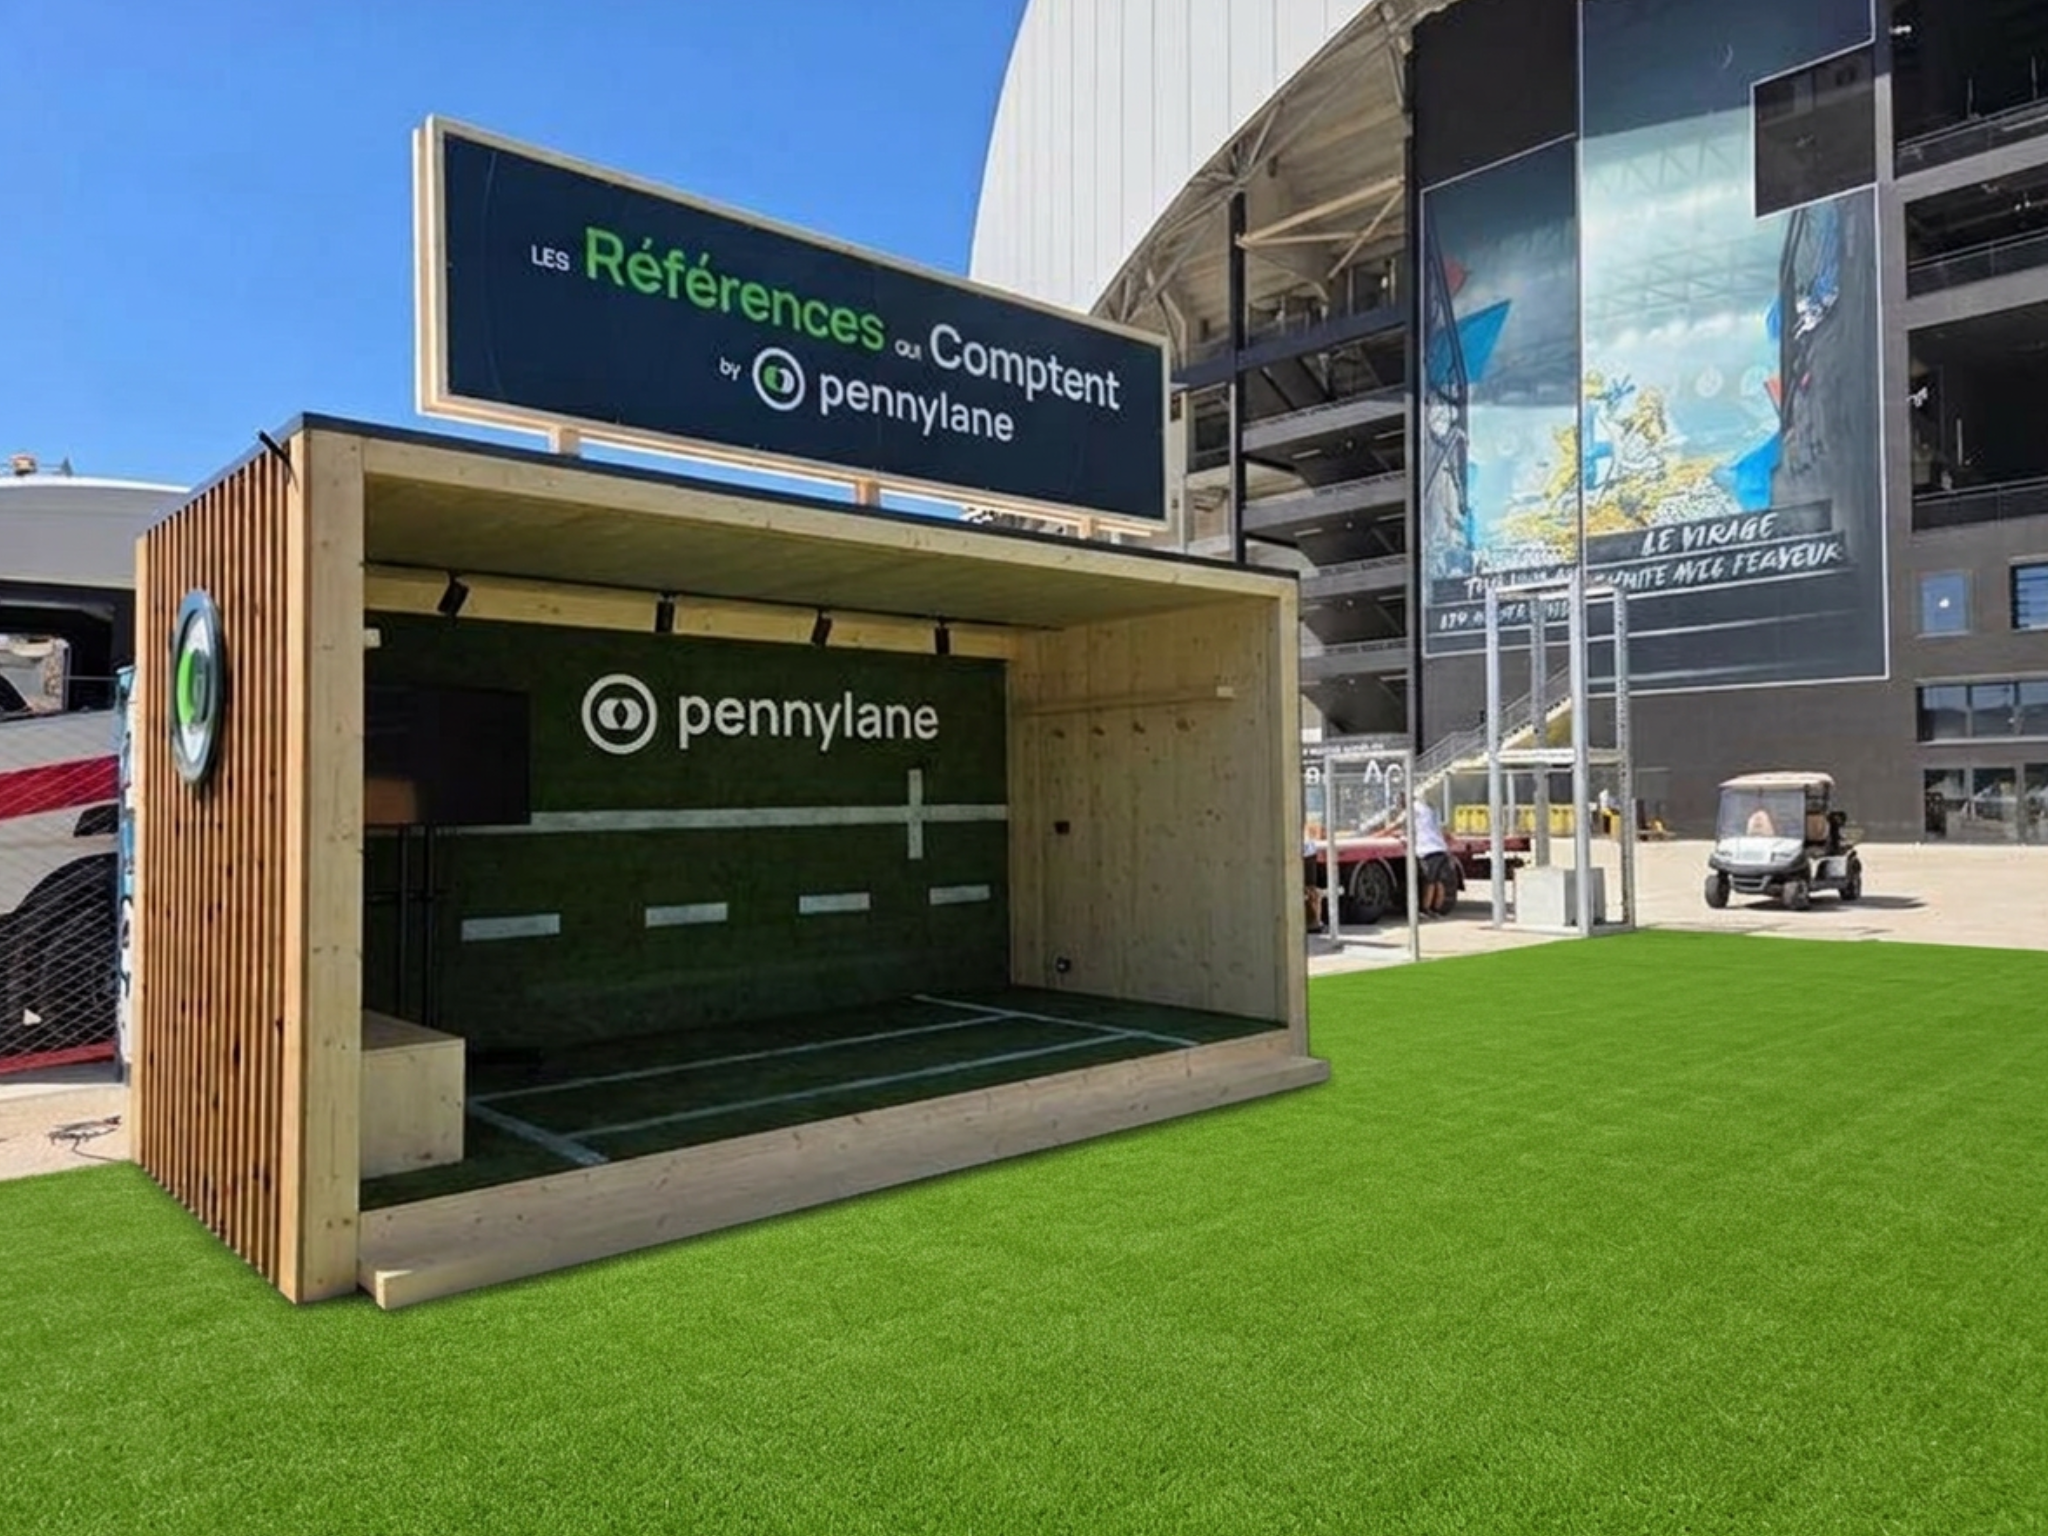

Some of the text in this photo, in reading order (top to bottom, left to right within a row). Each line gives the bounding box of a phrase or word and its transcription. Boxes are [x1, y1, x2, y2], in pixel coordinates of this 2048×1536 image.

[530, 243, 571, 272] LES
[584, 225, 887, 353] Références
[929, 322, 1121, 411] Comptent
[718, 356, 1015, 443] by pennylane
[1640, 511, 1780, 557] LE VIRAGE
[677, 690, 940, 753] pennylane
